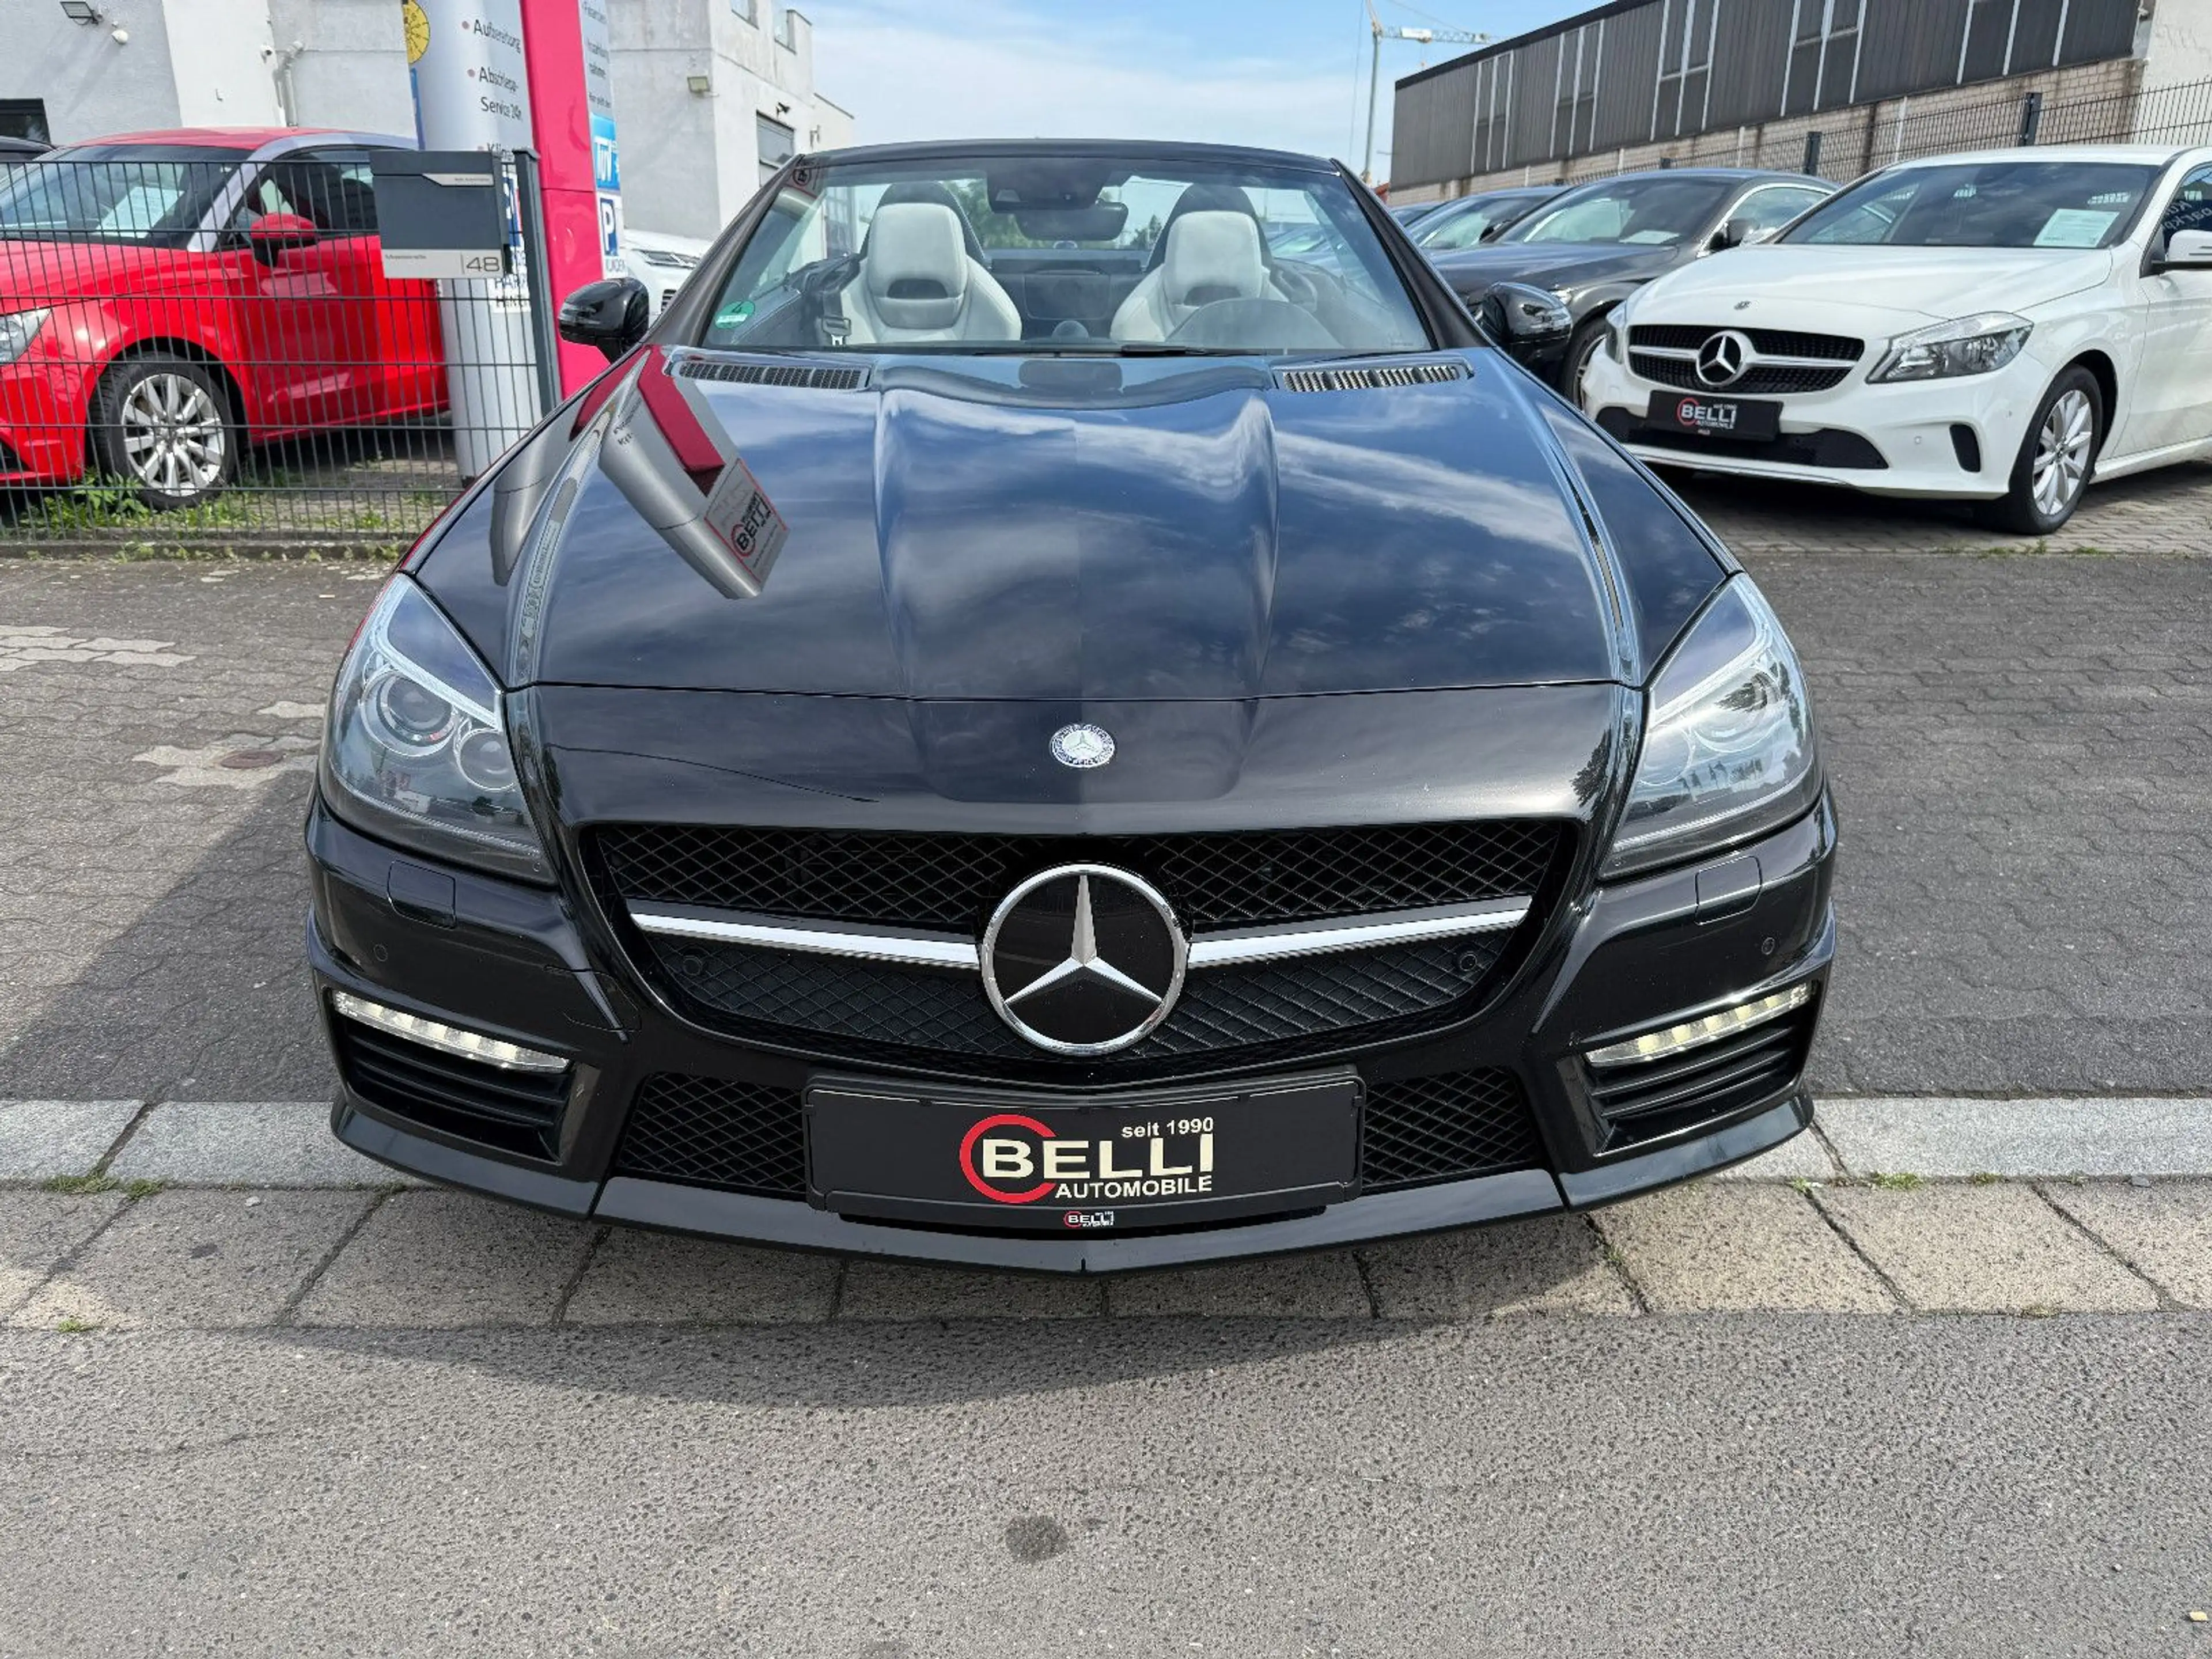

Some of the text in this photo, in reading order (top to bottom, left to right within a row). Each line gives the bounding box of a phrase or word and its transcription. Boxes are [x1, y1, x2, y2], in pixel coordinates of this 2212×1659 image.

[465, 256, 500, 272] 48
[1681, 404, 1736, 424] BELLI
[1122, 1117, 1214, 1139] seit 1990
[982, 1133, 1214, 1179] BELLI
[1055, 1175, 1212, 1199] AUTOMOBILE
[1068, 1213, 1114, 1224] BELLI
